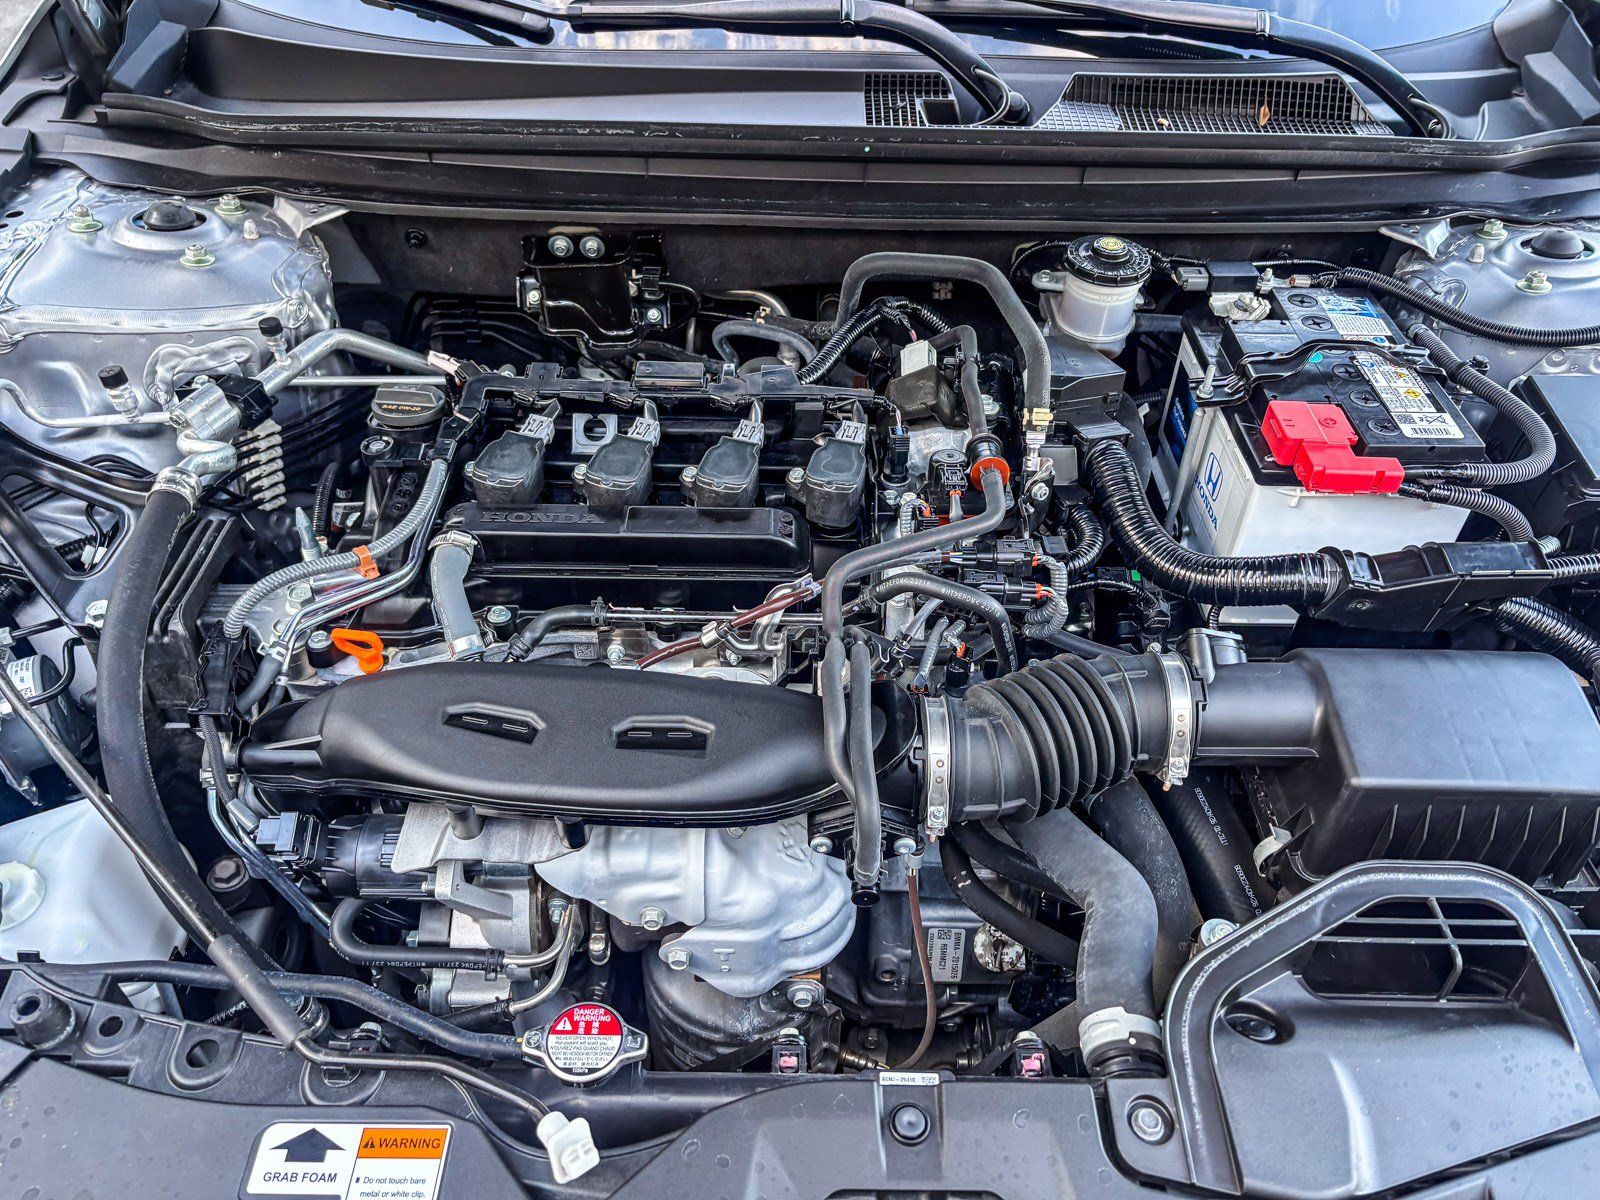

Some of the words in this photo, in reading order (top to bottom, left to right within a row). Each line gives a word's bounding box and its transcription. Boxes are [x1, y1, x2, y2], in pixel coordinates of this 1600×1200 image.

[1194, 474, 1218, 532] HONDA
[480, 511, 605, 524] HONDA
[573, 1014, 612, 1022] WARNUNG
[379, 1137, 441, 1149] WARNING
[263, 1171, 298, 1182] GRAB
[301, 1172, 338, 1183] FOAM
[363, 1176, 374, 1184] Do
[409, 1177, 426, 1185] bare
[360, 1190, 380, 1198] metal
[391, 1190, 410, 1198] white
[411, 1190, 426, 1199] clip.
